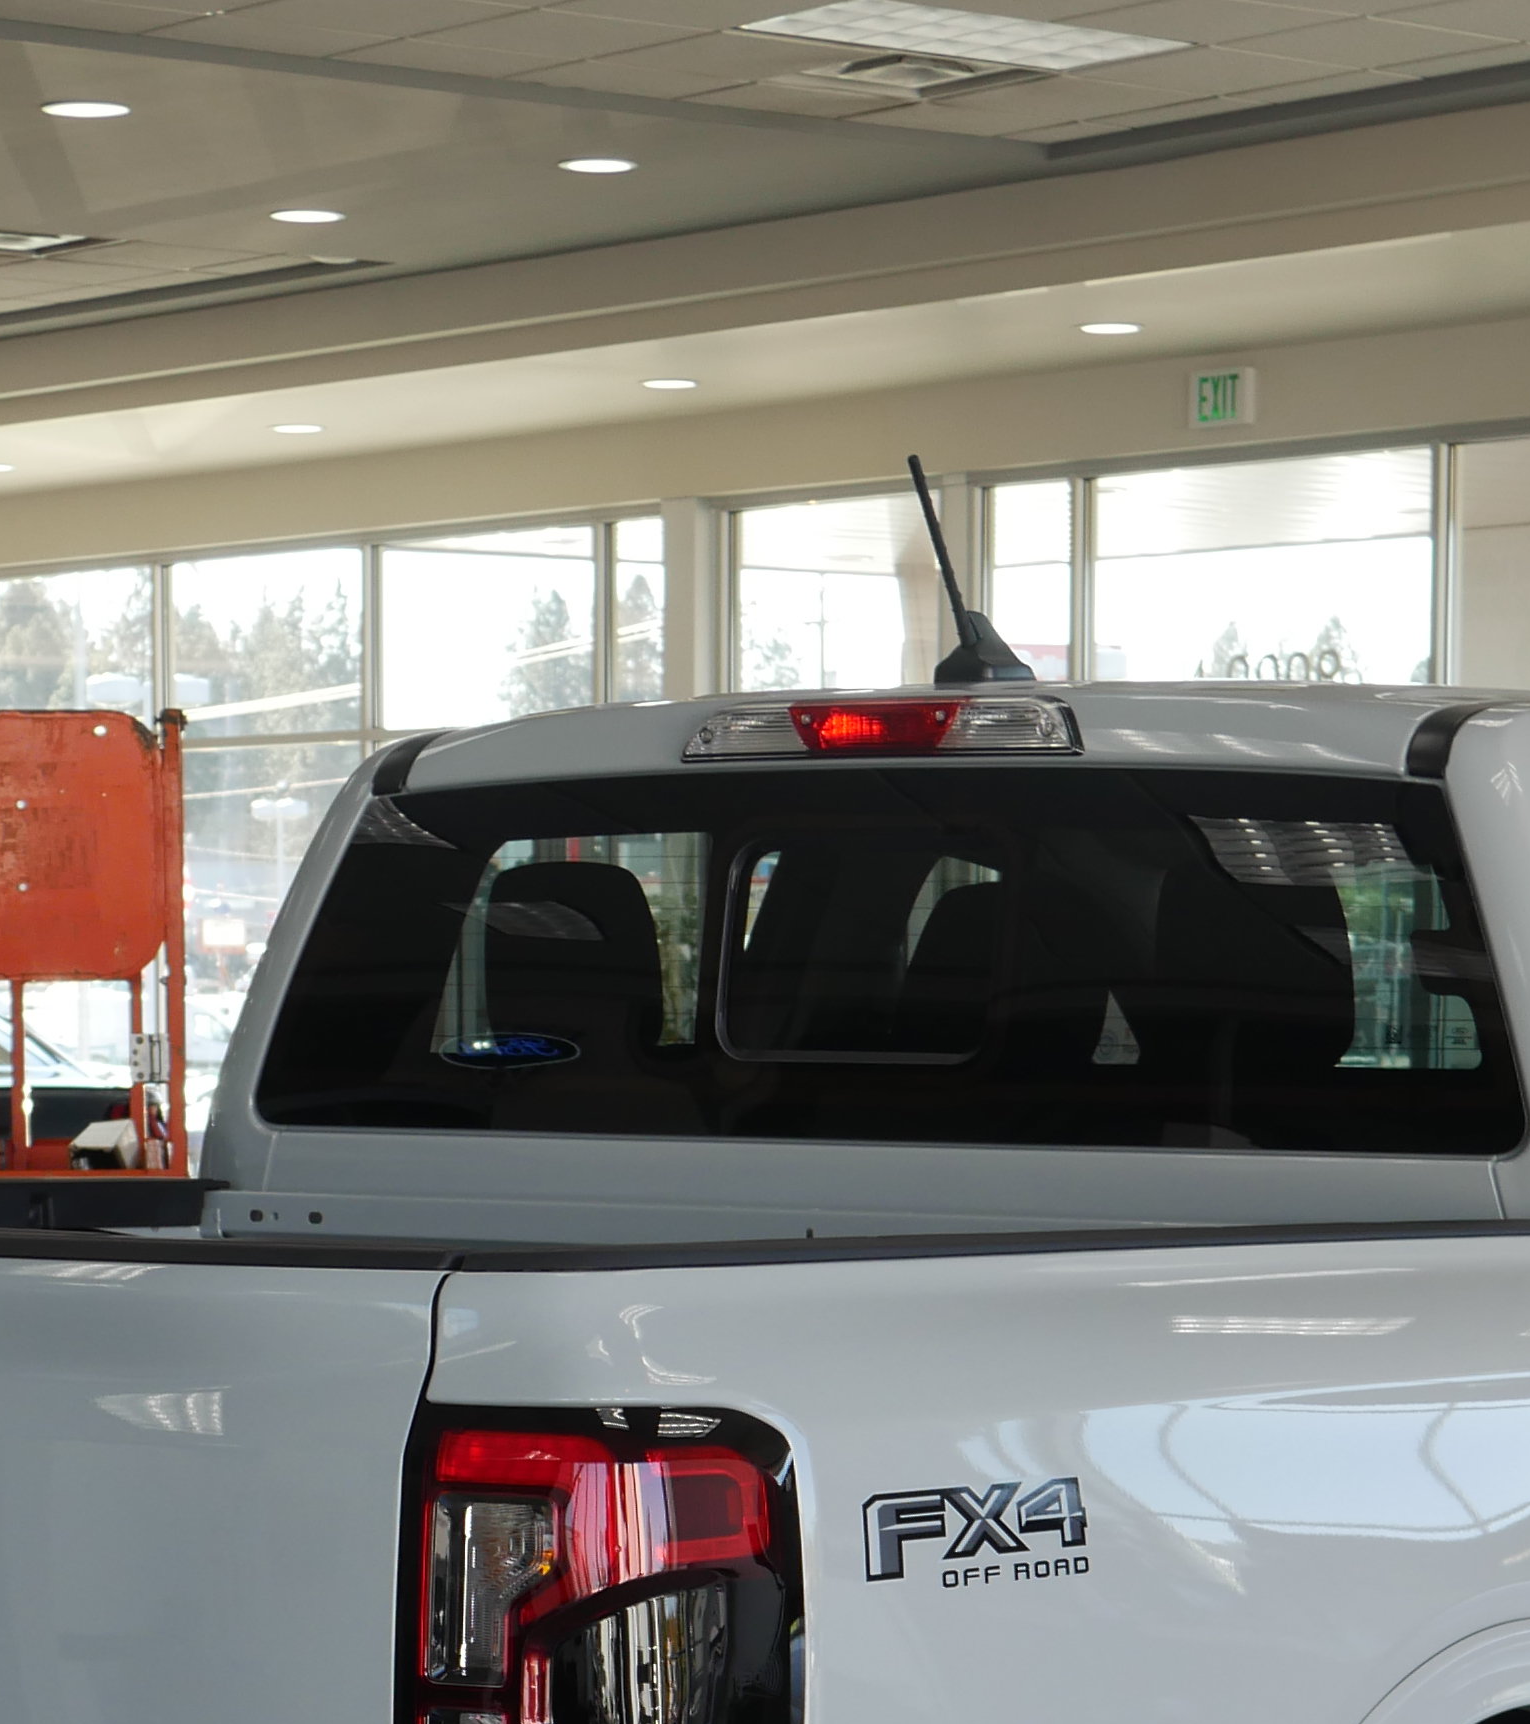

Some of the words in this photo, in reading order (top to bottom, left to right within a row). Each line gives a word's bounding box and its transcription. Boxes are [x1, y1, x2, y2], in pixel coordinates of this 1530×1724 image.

[1198, 373, 1239, 422] EXIT
[862, 1476, 1088, 1582] FX4
[942, 1565, 1001, 1589] OFF
[1014, 1556, 1089, 1581] ROAD
